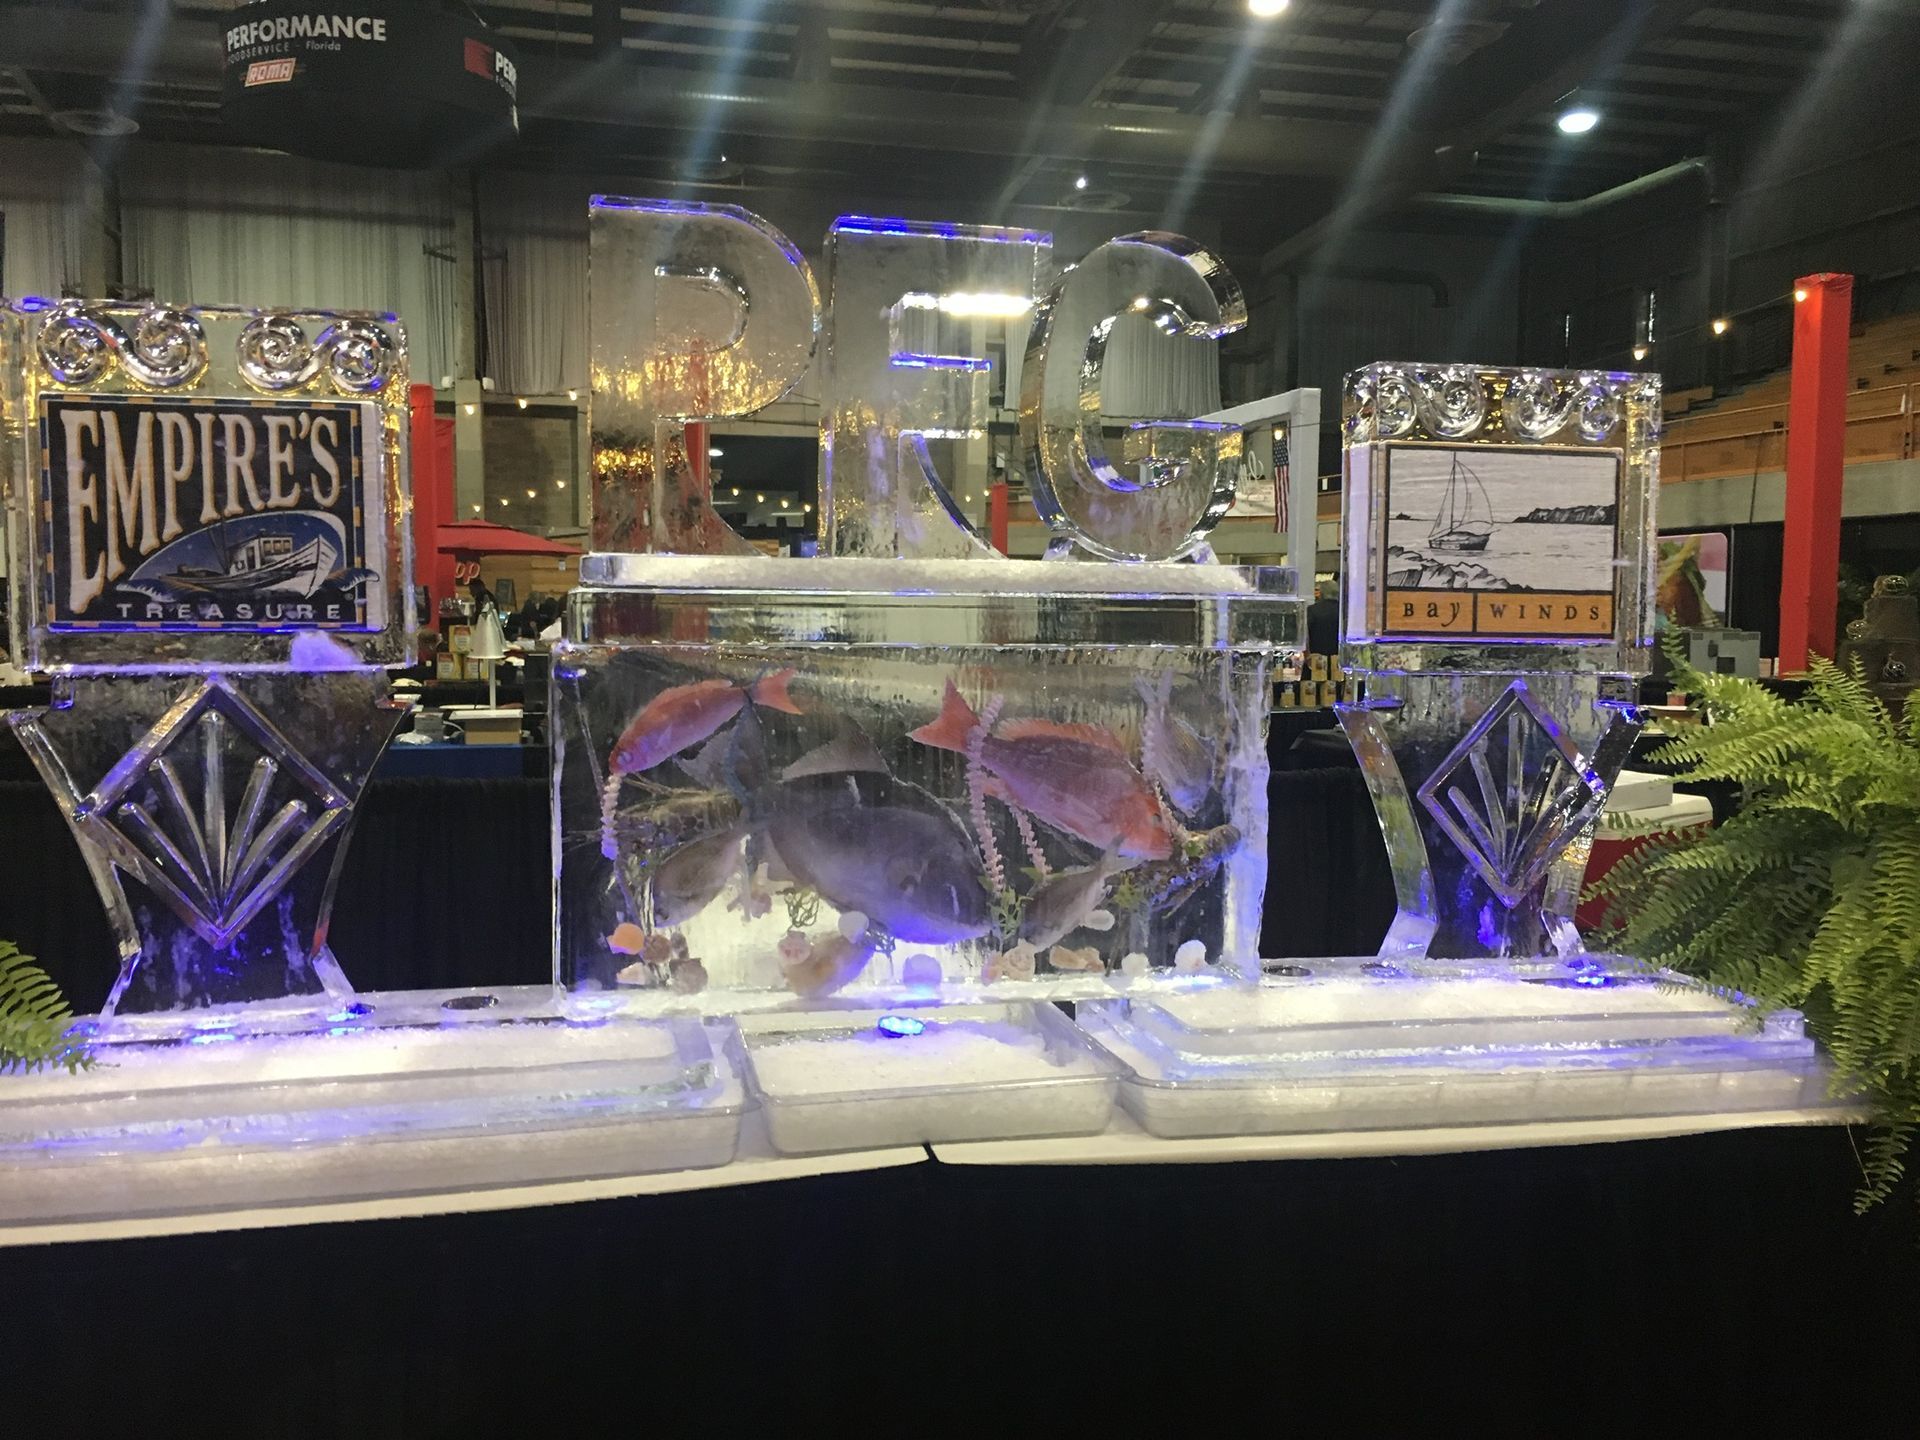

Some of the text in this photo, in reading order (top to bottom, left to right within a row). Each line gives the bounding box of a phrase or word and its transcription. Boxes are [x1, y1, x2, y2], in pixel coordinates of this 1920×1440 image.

[227, 14, 387, 51] PERFORMANCE
[227, 42, 290, 64] OODSERVICE
[305, 40, 341, 51] Florida
[249, 61, 291, 82] ROMA
[60, 408, 340, 614] EMPIRE'S
[116, 603, 341, 620] TREASURE
[1489, 603, 1600, 621] WINDS
